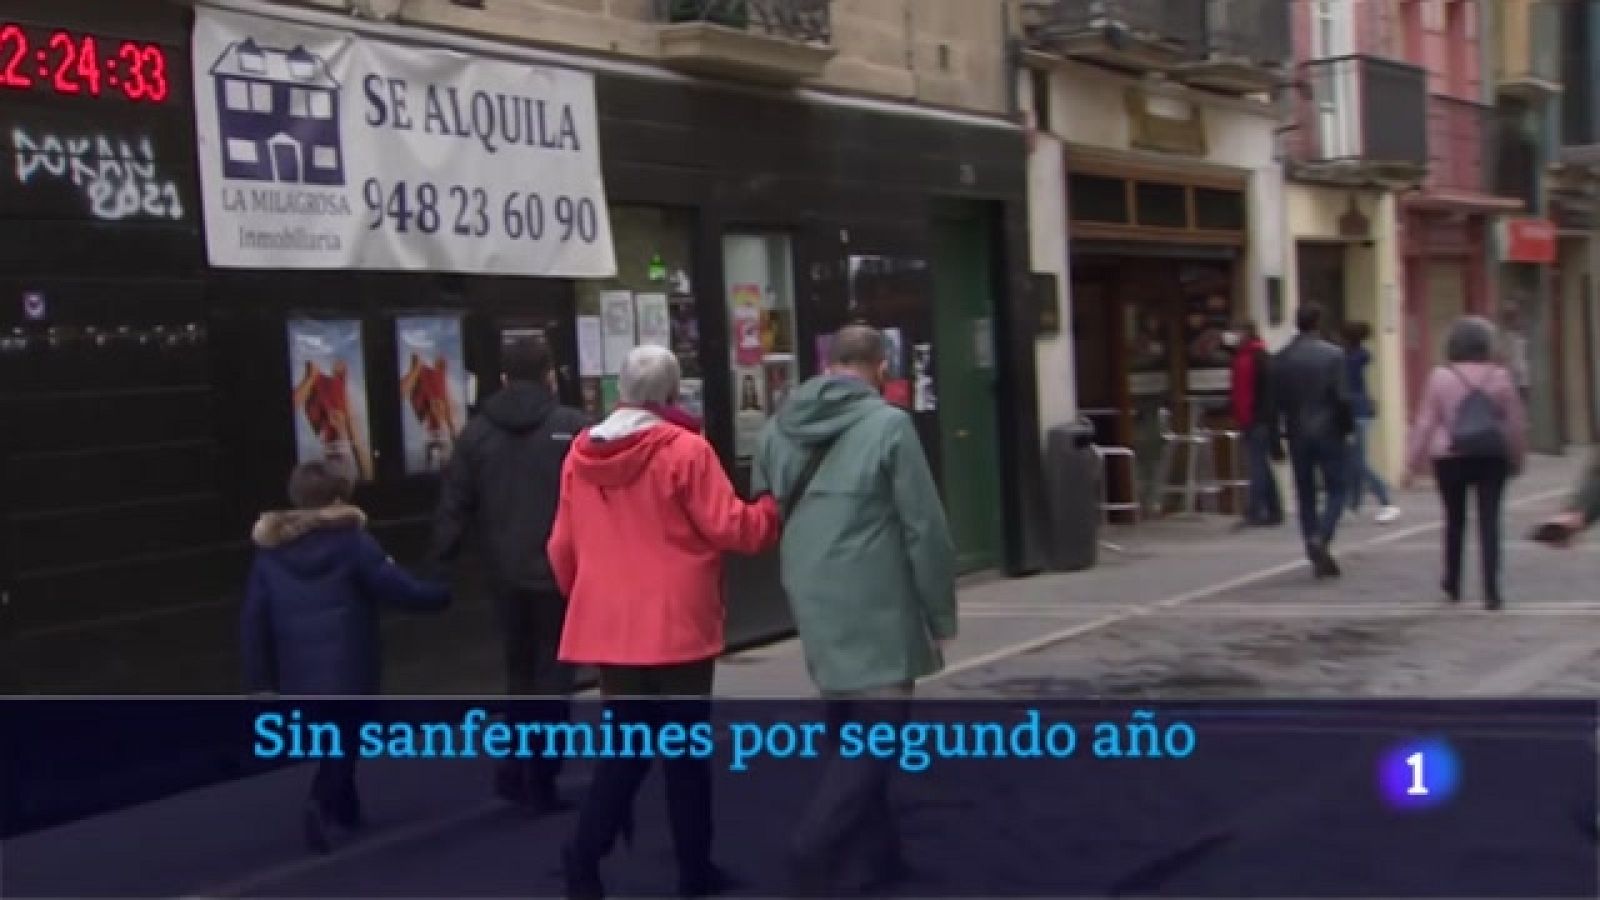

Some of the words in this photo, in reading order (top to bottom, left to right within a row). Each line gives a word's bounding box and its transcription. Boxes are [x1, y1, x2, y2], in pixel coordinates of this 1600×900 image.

[363, 72, 413, 130] SE
[424, 82, 581, 154] ALQUILA
[222, 187, 247, 213] LA
[250, 189, 352, 216] MILAGROSA
[363, 176, 440, 233] 948
[449, 185, 490, 236] 23
[504, 191, 545, 241] 60
[554, 195, 598, 243] 90
